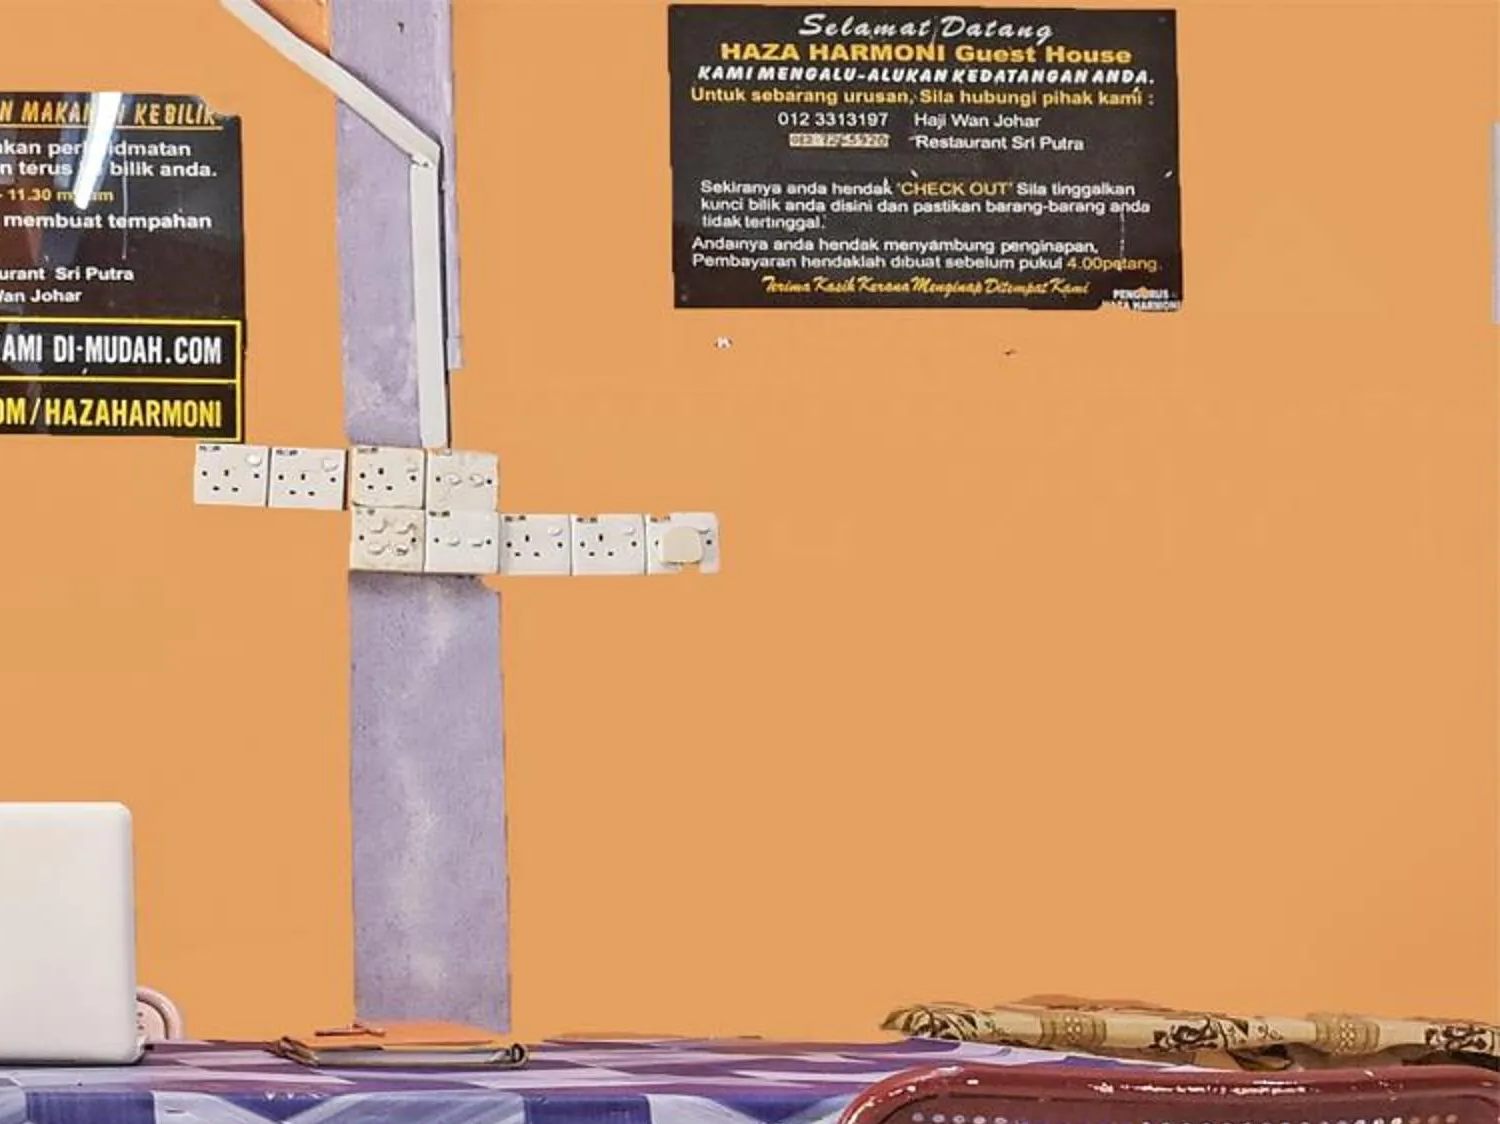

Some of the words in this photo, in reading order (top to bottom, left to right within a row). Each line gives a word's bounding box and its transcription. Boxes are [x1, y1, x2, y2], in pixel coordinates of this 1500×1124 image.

[798, 13, 931, 37] Selamat
[941, 16, 1053, 46] Datang
[720, 43, 800, 62] HAZA
[809, 44, 945, 62] HARMONI
[955, 45, 1036, 63] Guest
[1046, 46, 1132, 64] House
[698, 66, 753, 81] KAMI
[757, 66, 947, 83] MENGALU-ALUKAN
[952, 68, 1088, 84] KEDATANGAN
[1092, 69, 1155, 85] ANDA.
[691, 87, 746, 102] Untuk
[751, 87, 837, 106] sebarang
[920, 88, 954, 103] Sila
[960, 89, 1037, 107] hubungi
[1043, 90, 1093, 108] pihak
[1100, 91, 1142, 105] kami
[21, 100, 125, 125] MAKANN
[777, 112, 809, 126] 012
[815, 112, 889, 127] 3313197
[914, 113, 946, 130] Haji
[951, 114, 989, 127] Wan
[993, 114, 1041, 128] Johar
[47, 140, 191, 159] peridmatan
[915, 135, 1008, 150] Restaurant
[1012, 136, 1035, 150] Sri
[1040, 136, 1084, 150] Putra
[18, 162, 73, 176] terus
[110, 161, 154, 177] bilik
[159, 161, 218, 177] anda.
[9, 187, 52, 201] 11.30
[700, 180, 781, 196] Sekiranya
[787, 181, 827, 195] anda
[832, 180, 893, 195] hendak
[1016, 181, 1047, 196] Sila
[1052, 182, 1135, 199] tinggalkan
[701, 198, 743, 212] kunci
[749, 199, 780, 212] bilik
[785, 199, 826, 212] anda
[830, 200, 873, 213] disini
[877, 200, 908, 213] dan
[913, 201, 981, 216] pastikan
[986, 201, 1106, 217] barang-barang
[1110, 202, 1150, 214] anda
[3, 212, 103, 229] membuat
[108, 213, 213, 232] tempahan
[702, 215, 742, 229] tidak
[692, 236, 768, 253] Andainya
[773, 238, 814, 251] anda
[819, 238, 879, 252] hendak
[884, 239, 995, 255] menyambung
[692, 253, 797, 271] Pembayaran
[801, 254, 885, 269] hendaklah
[890, 255, 941, 269] dibuat
[945, 256, 1015, 270] sebelum
[1019, 256, 1063, 272] pukul
[55, 267, 80, 281] Sri
[85, 267, 135, 281] Putra
[30, 289, 82, 303] Johar
